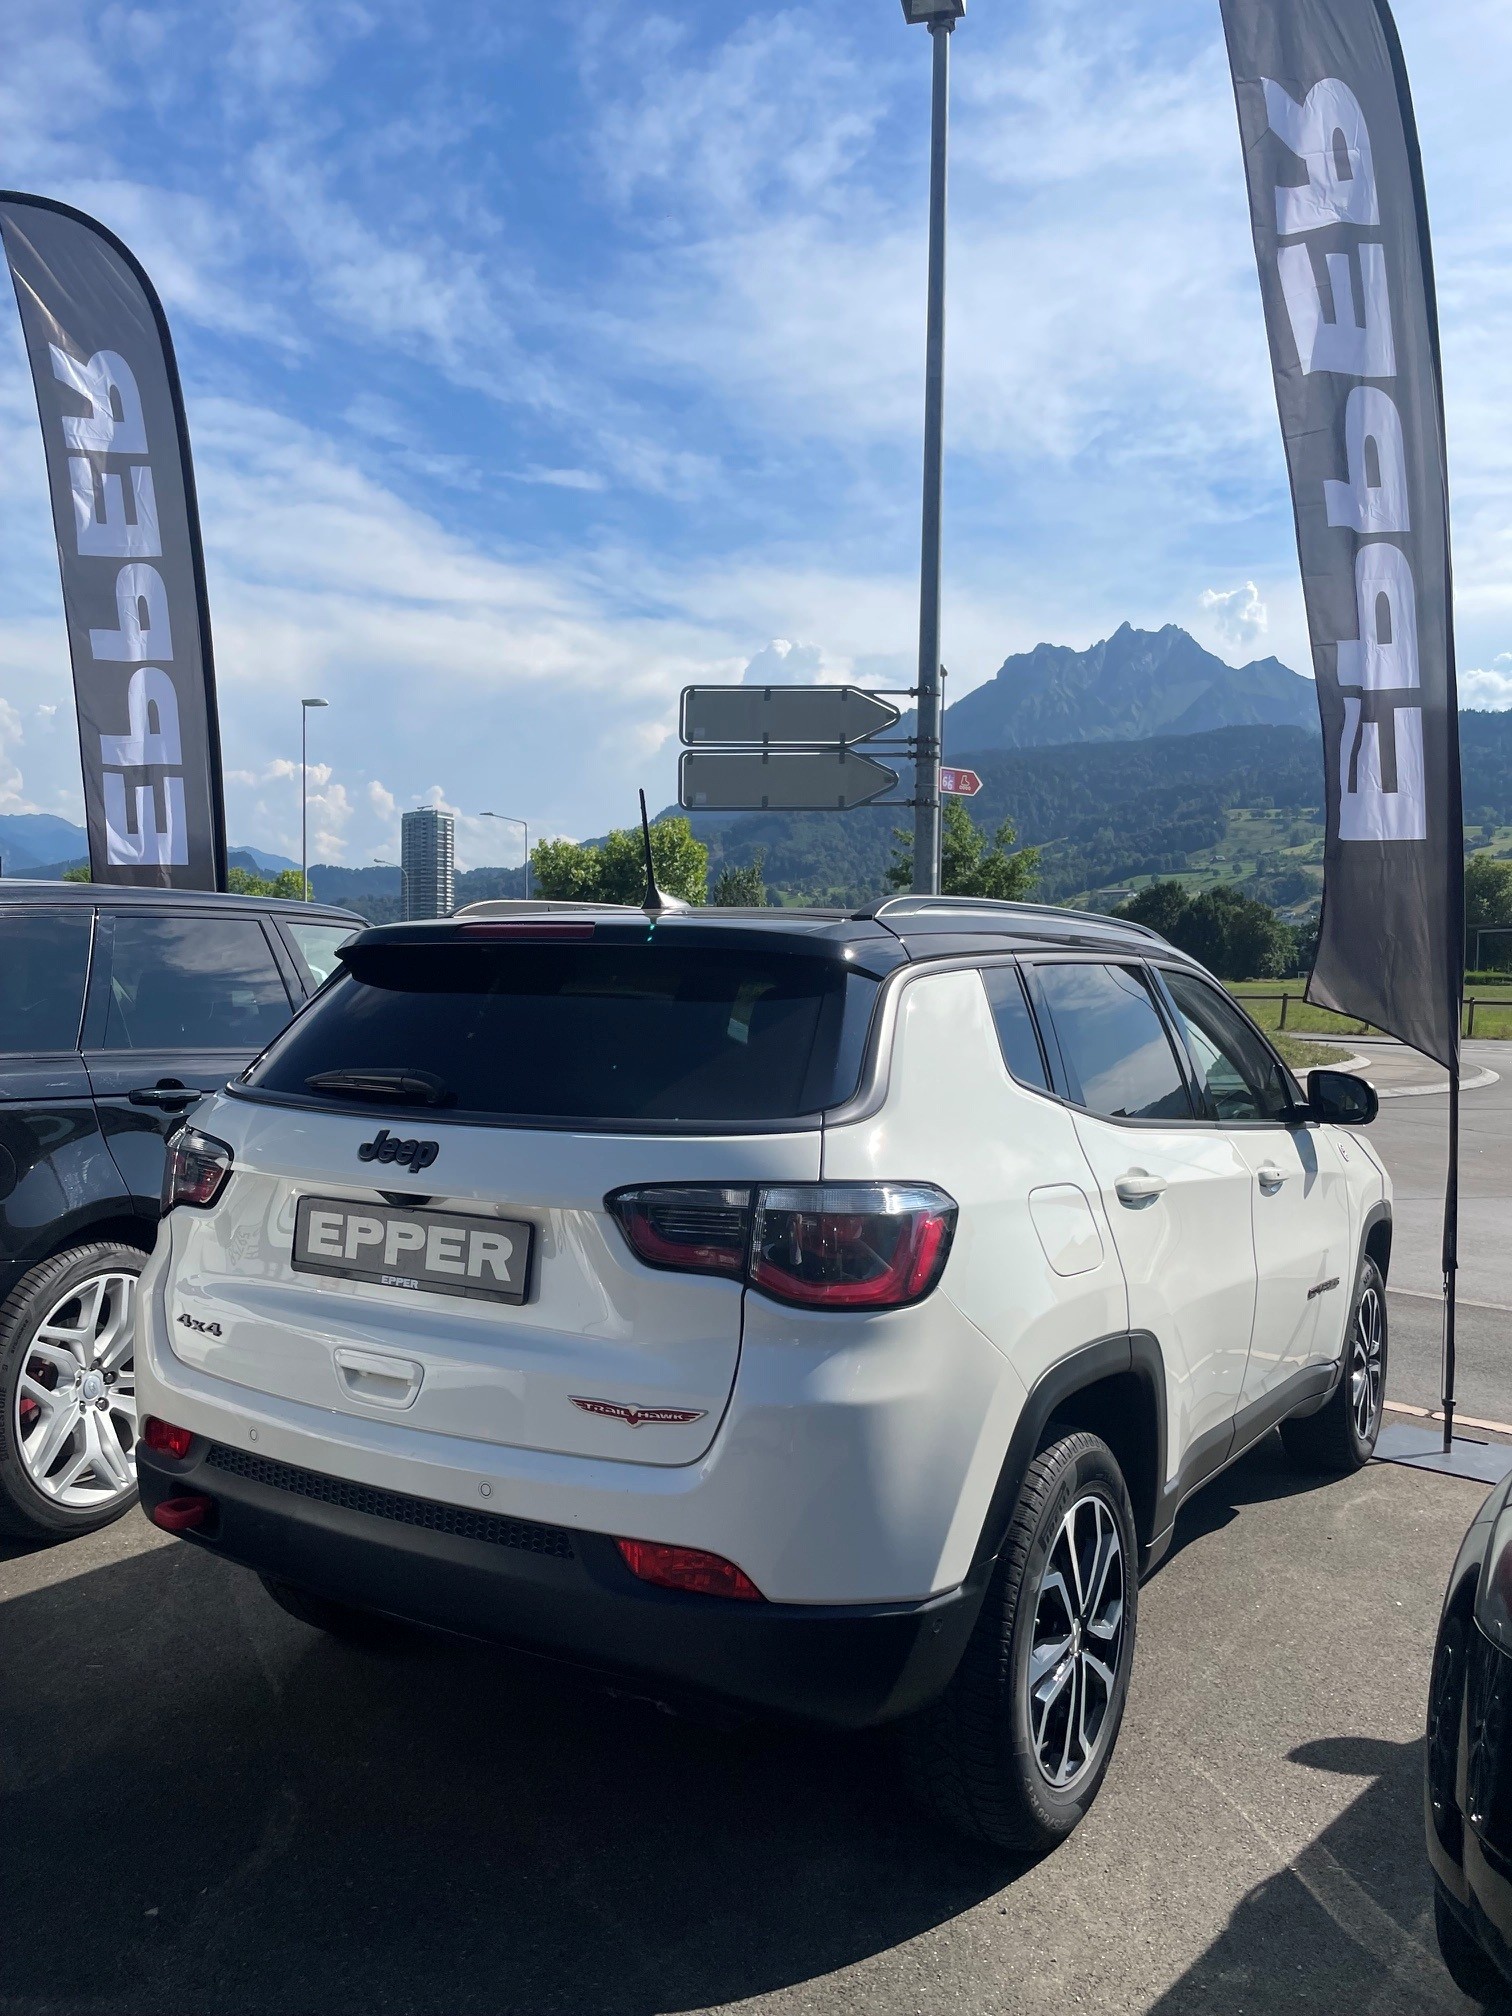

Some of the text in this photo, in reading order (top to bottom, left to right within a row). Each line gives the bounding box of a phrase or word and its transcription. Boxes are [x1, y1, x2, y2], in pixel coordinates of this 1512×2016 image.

[358, 1129, 439, 1174] Jeep
[306, 1210, 513, 1282] EPPER
[381, 1274, 418, 1290] EPPER
[176, 1313, 222, 1338] 4x4
